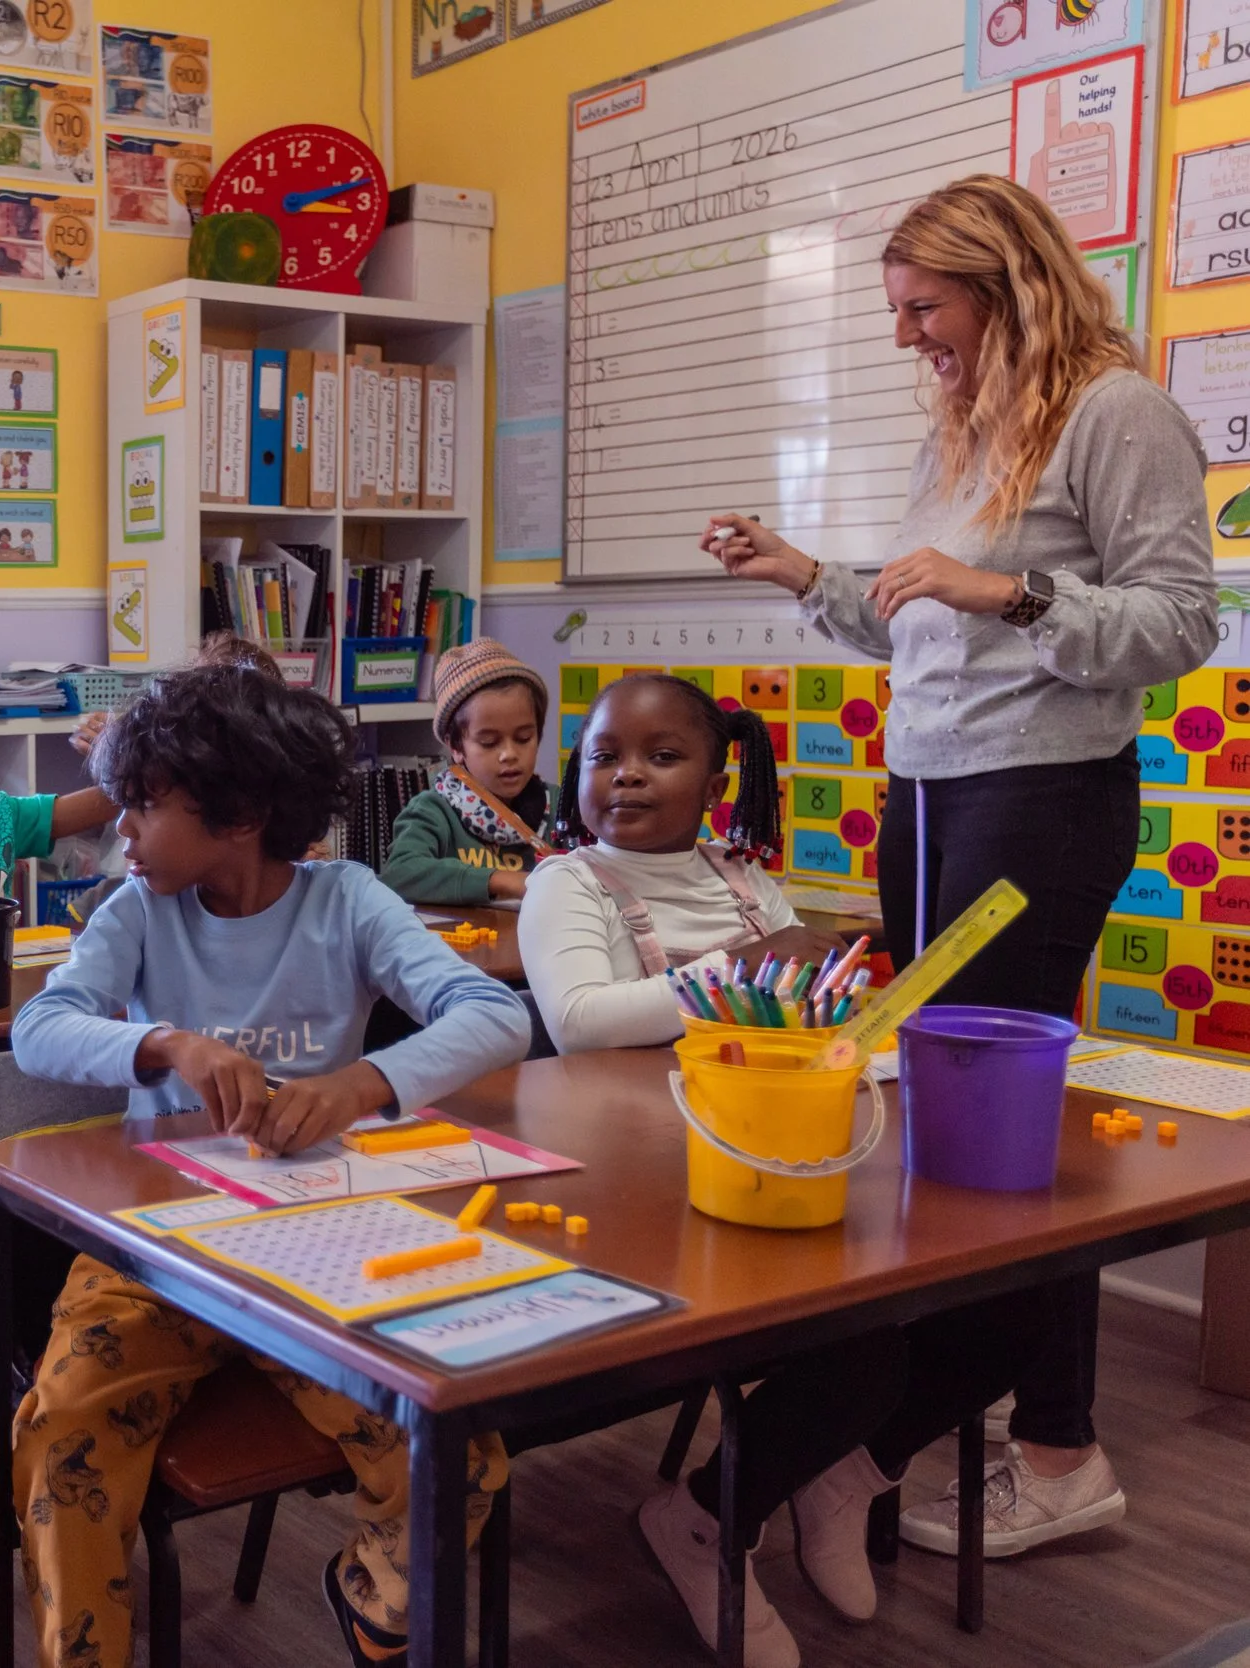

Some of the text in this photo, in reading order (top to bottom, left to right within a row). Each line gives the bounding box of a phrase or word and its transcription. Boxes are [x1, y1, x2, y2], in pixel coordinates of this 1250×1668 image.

[1079, 74, 1099, 86] Our
[1078, 85, 1117, 102] helping
[1078, 100, 1113, 118] hands!
[53, 112, 83, 138] R10
[286, 140, 312, 159] 12
[730, 122, 798, 166] 2026
[253, 152, 275, 171] 11
[326, 146, 336, 164] 1
[350, 166, 364, 183] 2
[230, 175, 255, 194] 10
[356, 192, 371, 211] 3
[54, 225, 87, 247] R50
[344, 223, 358, 242] 4
[284, 256, 298, 275] 6
[318, 246, 332, 266] 5
[297, 401, 306, 445] CEMIS
[1226, 414, 1249, 454] g
[602, 630, 611, 646] 2
[627, 629, 636, 646] 3
[652, 629, 662, 647] 4
[678, 628, 688, 645] 5
[707, 628, 716, 645] 6
[735, 628, 744, 645] 7
[764, 627, 774, 644] 8
[795, 626, 805, 644] 9
[281, 664, 310, 677] eracy
[362, 663, 415, 680] Numeracy
[577, 674, 584, 697] 1
[813, 676, 827, 703] 3
[848, 709, 875, 728] 3rd
[1179, 718, 1220, 740] 5th
[806, 740, 844, 757] three
[1139, 756, 1166, 769] ive
[810, 785, 826, 811] 8
[844, 820, 873, 838] 8th
[1138, 816, 1153, 845] 0
[457, 846, 524, 872] WILD
[804, 848, 839, 867] eight
[1171, 853, 1217, 876] 10th
[1128, 884, 1163, 901] ten
[1122, 934, 1149, 964] 15
[1166, 975, 1211, 999] 15th
[1116, 1006, 1161, 1026] fifteen
